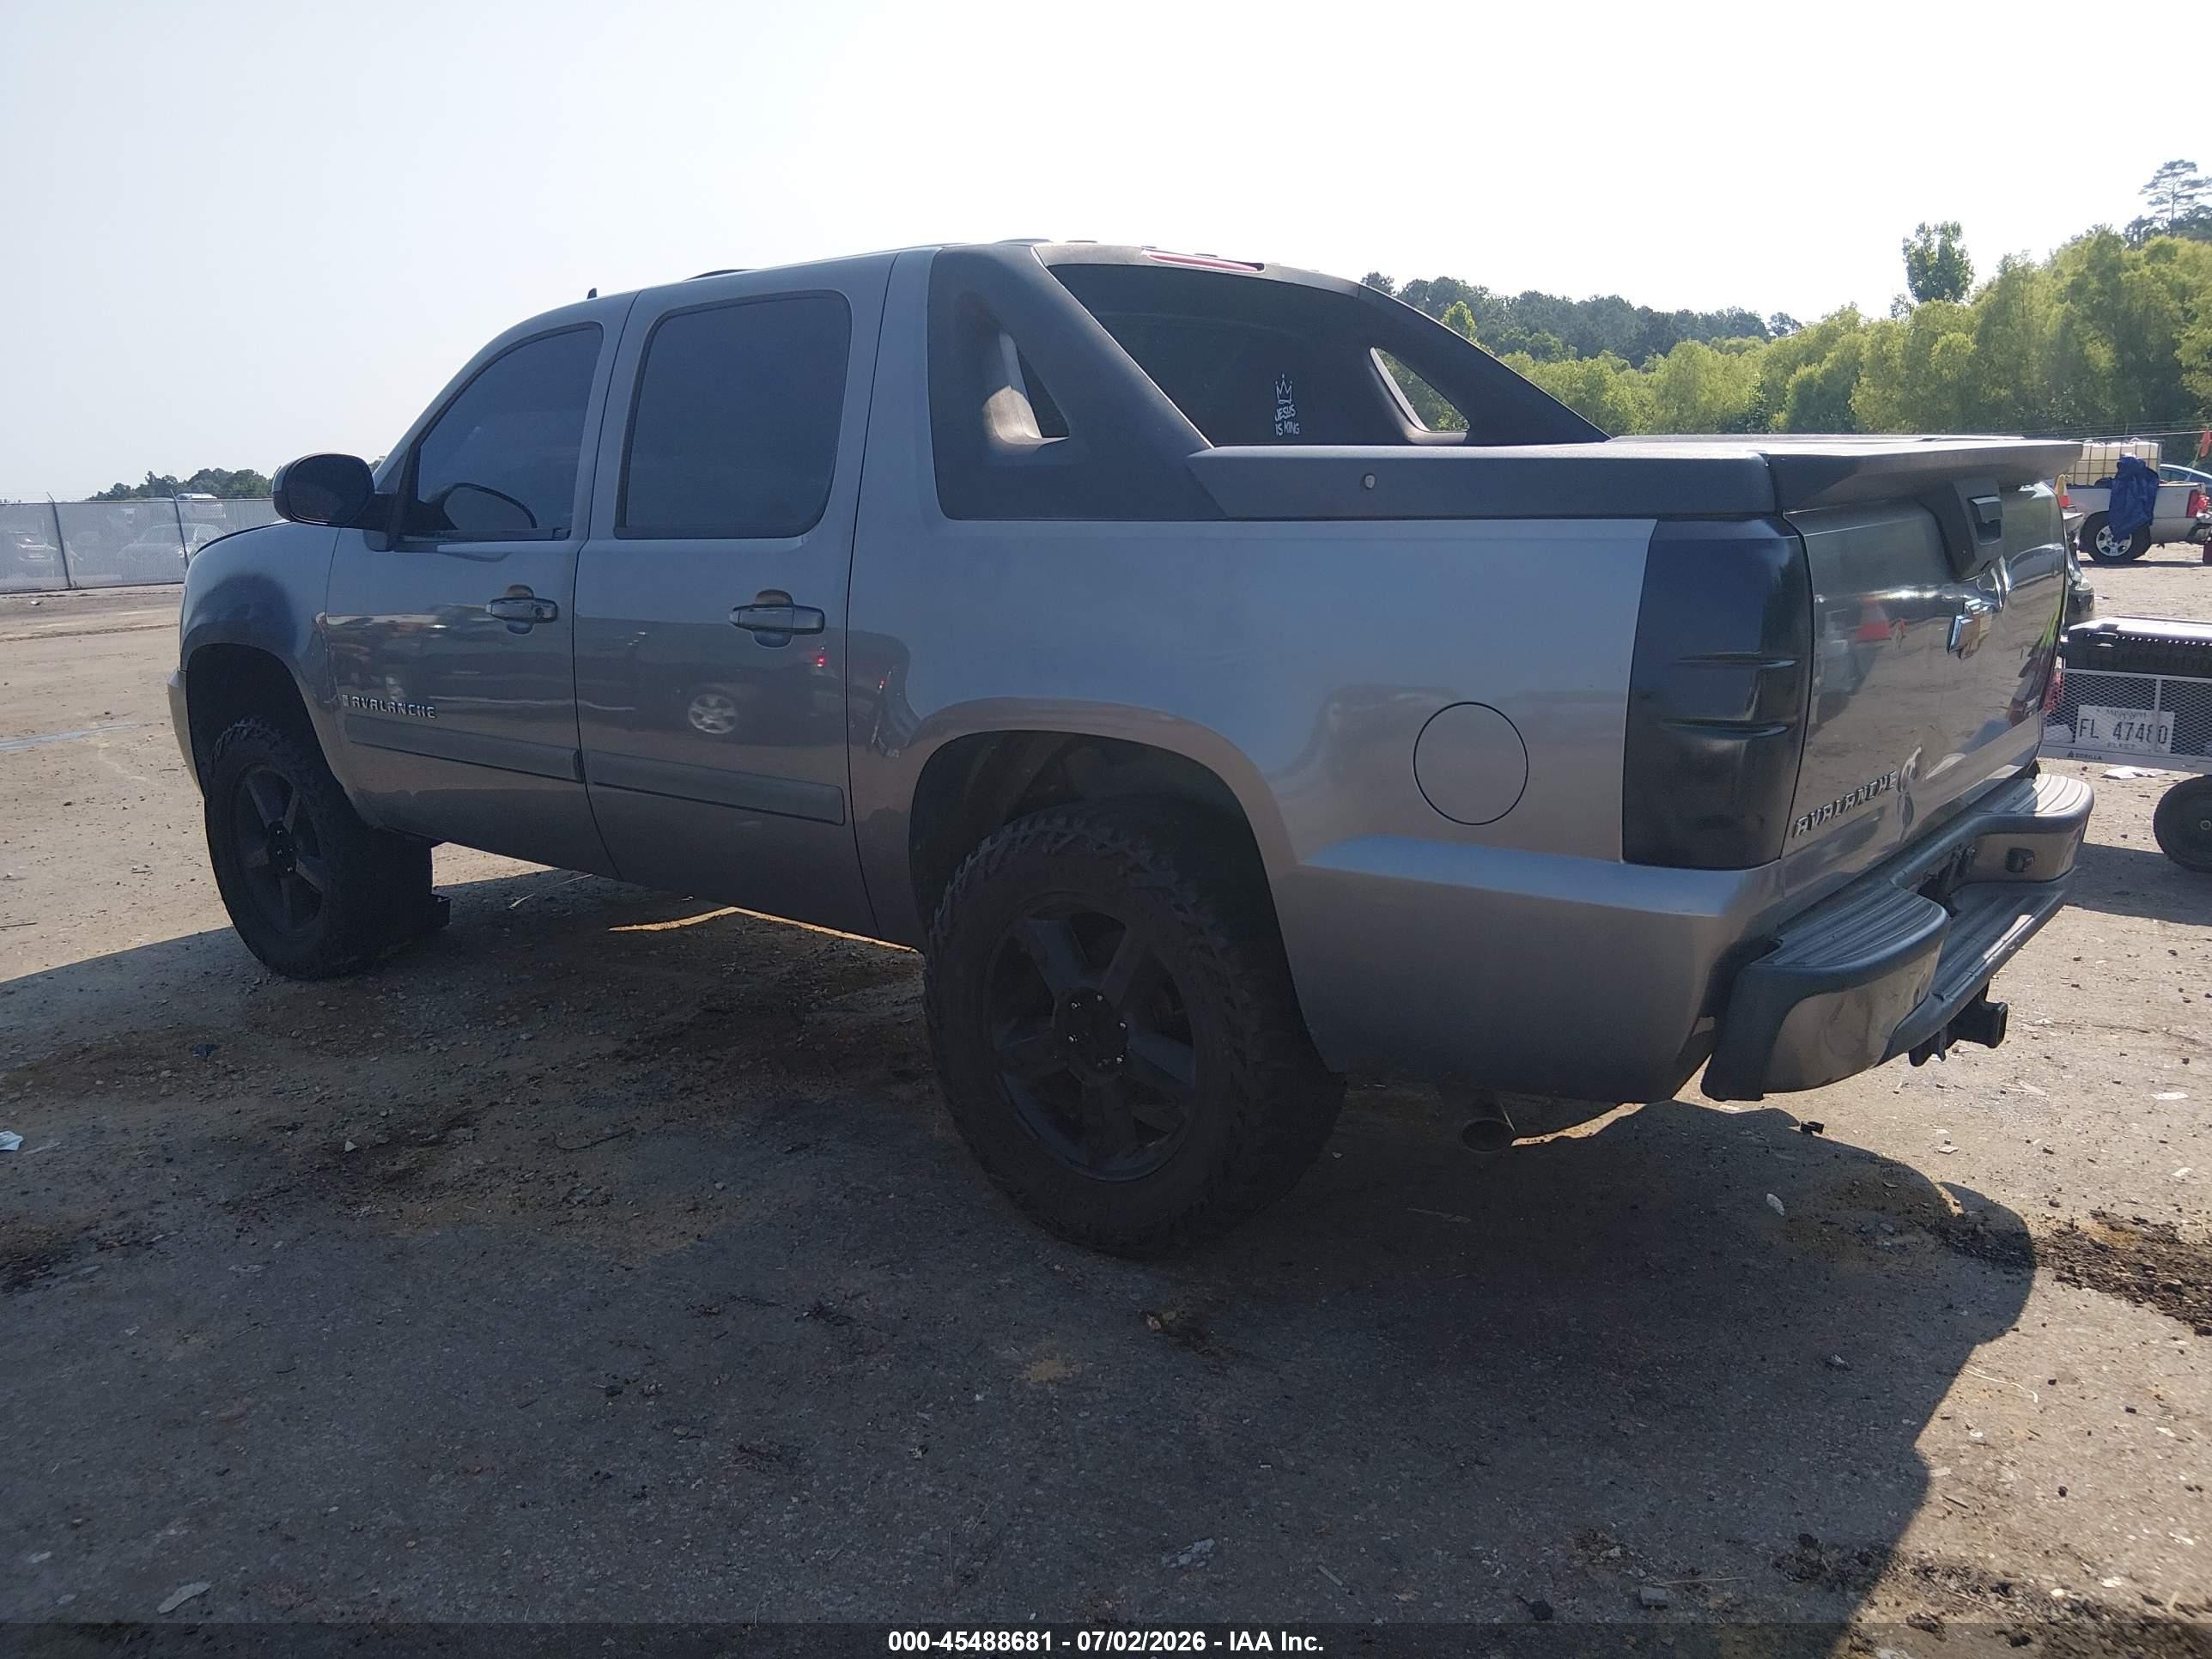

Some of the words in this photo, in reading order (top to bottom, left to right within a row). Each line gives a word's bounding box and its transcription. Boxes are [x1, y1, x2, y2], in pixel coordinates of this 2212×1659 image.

[1275, 404, 1296, 422] JESUS
[1275, 422, 1284, 436] IS
[1284, 421, 1300, 435] KING
[352, 696, 436, 719] AVALANCHE
[2079, 719, 2100, 739] FL
[1792, 770, 1897, 838] AVALANCHE
